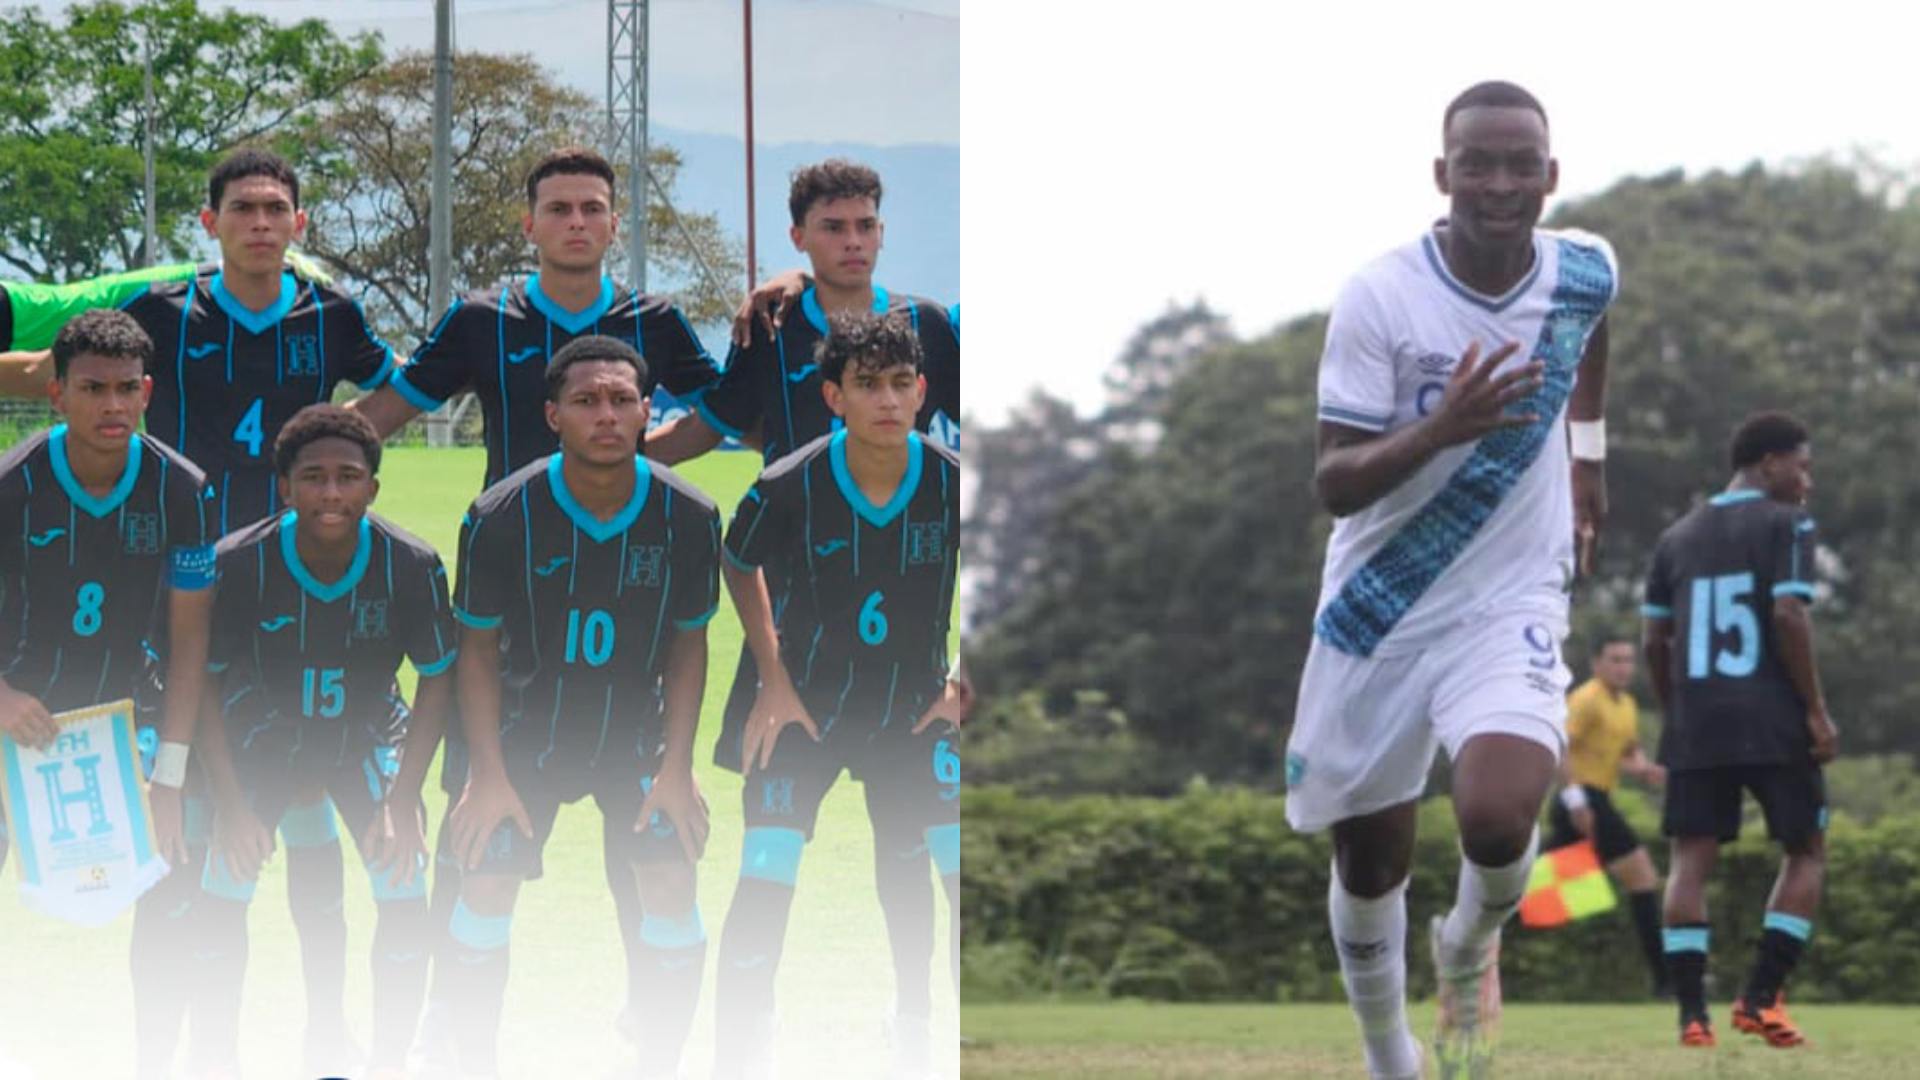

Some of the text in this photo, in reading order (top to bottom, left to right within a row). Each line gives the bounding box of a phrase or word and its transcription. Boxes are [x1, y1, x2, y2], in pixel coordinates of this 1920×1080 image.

[233, 397, 264, 456] 4
[73, 581, 105, 636] 8
[858, 591, 888, 646] 6
[1688, 572, 1760, 679] 15
[565, 608, 615, 667] 10
[1523, 622, 1556, 669] 9
[302, 667, 345, 718] 15
[36, 753, 113, 842] H
